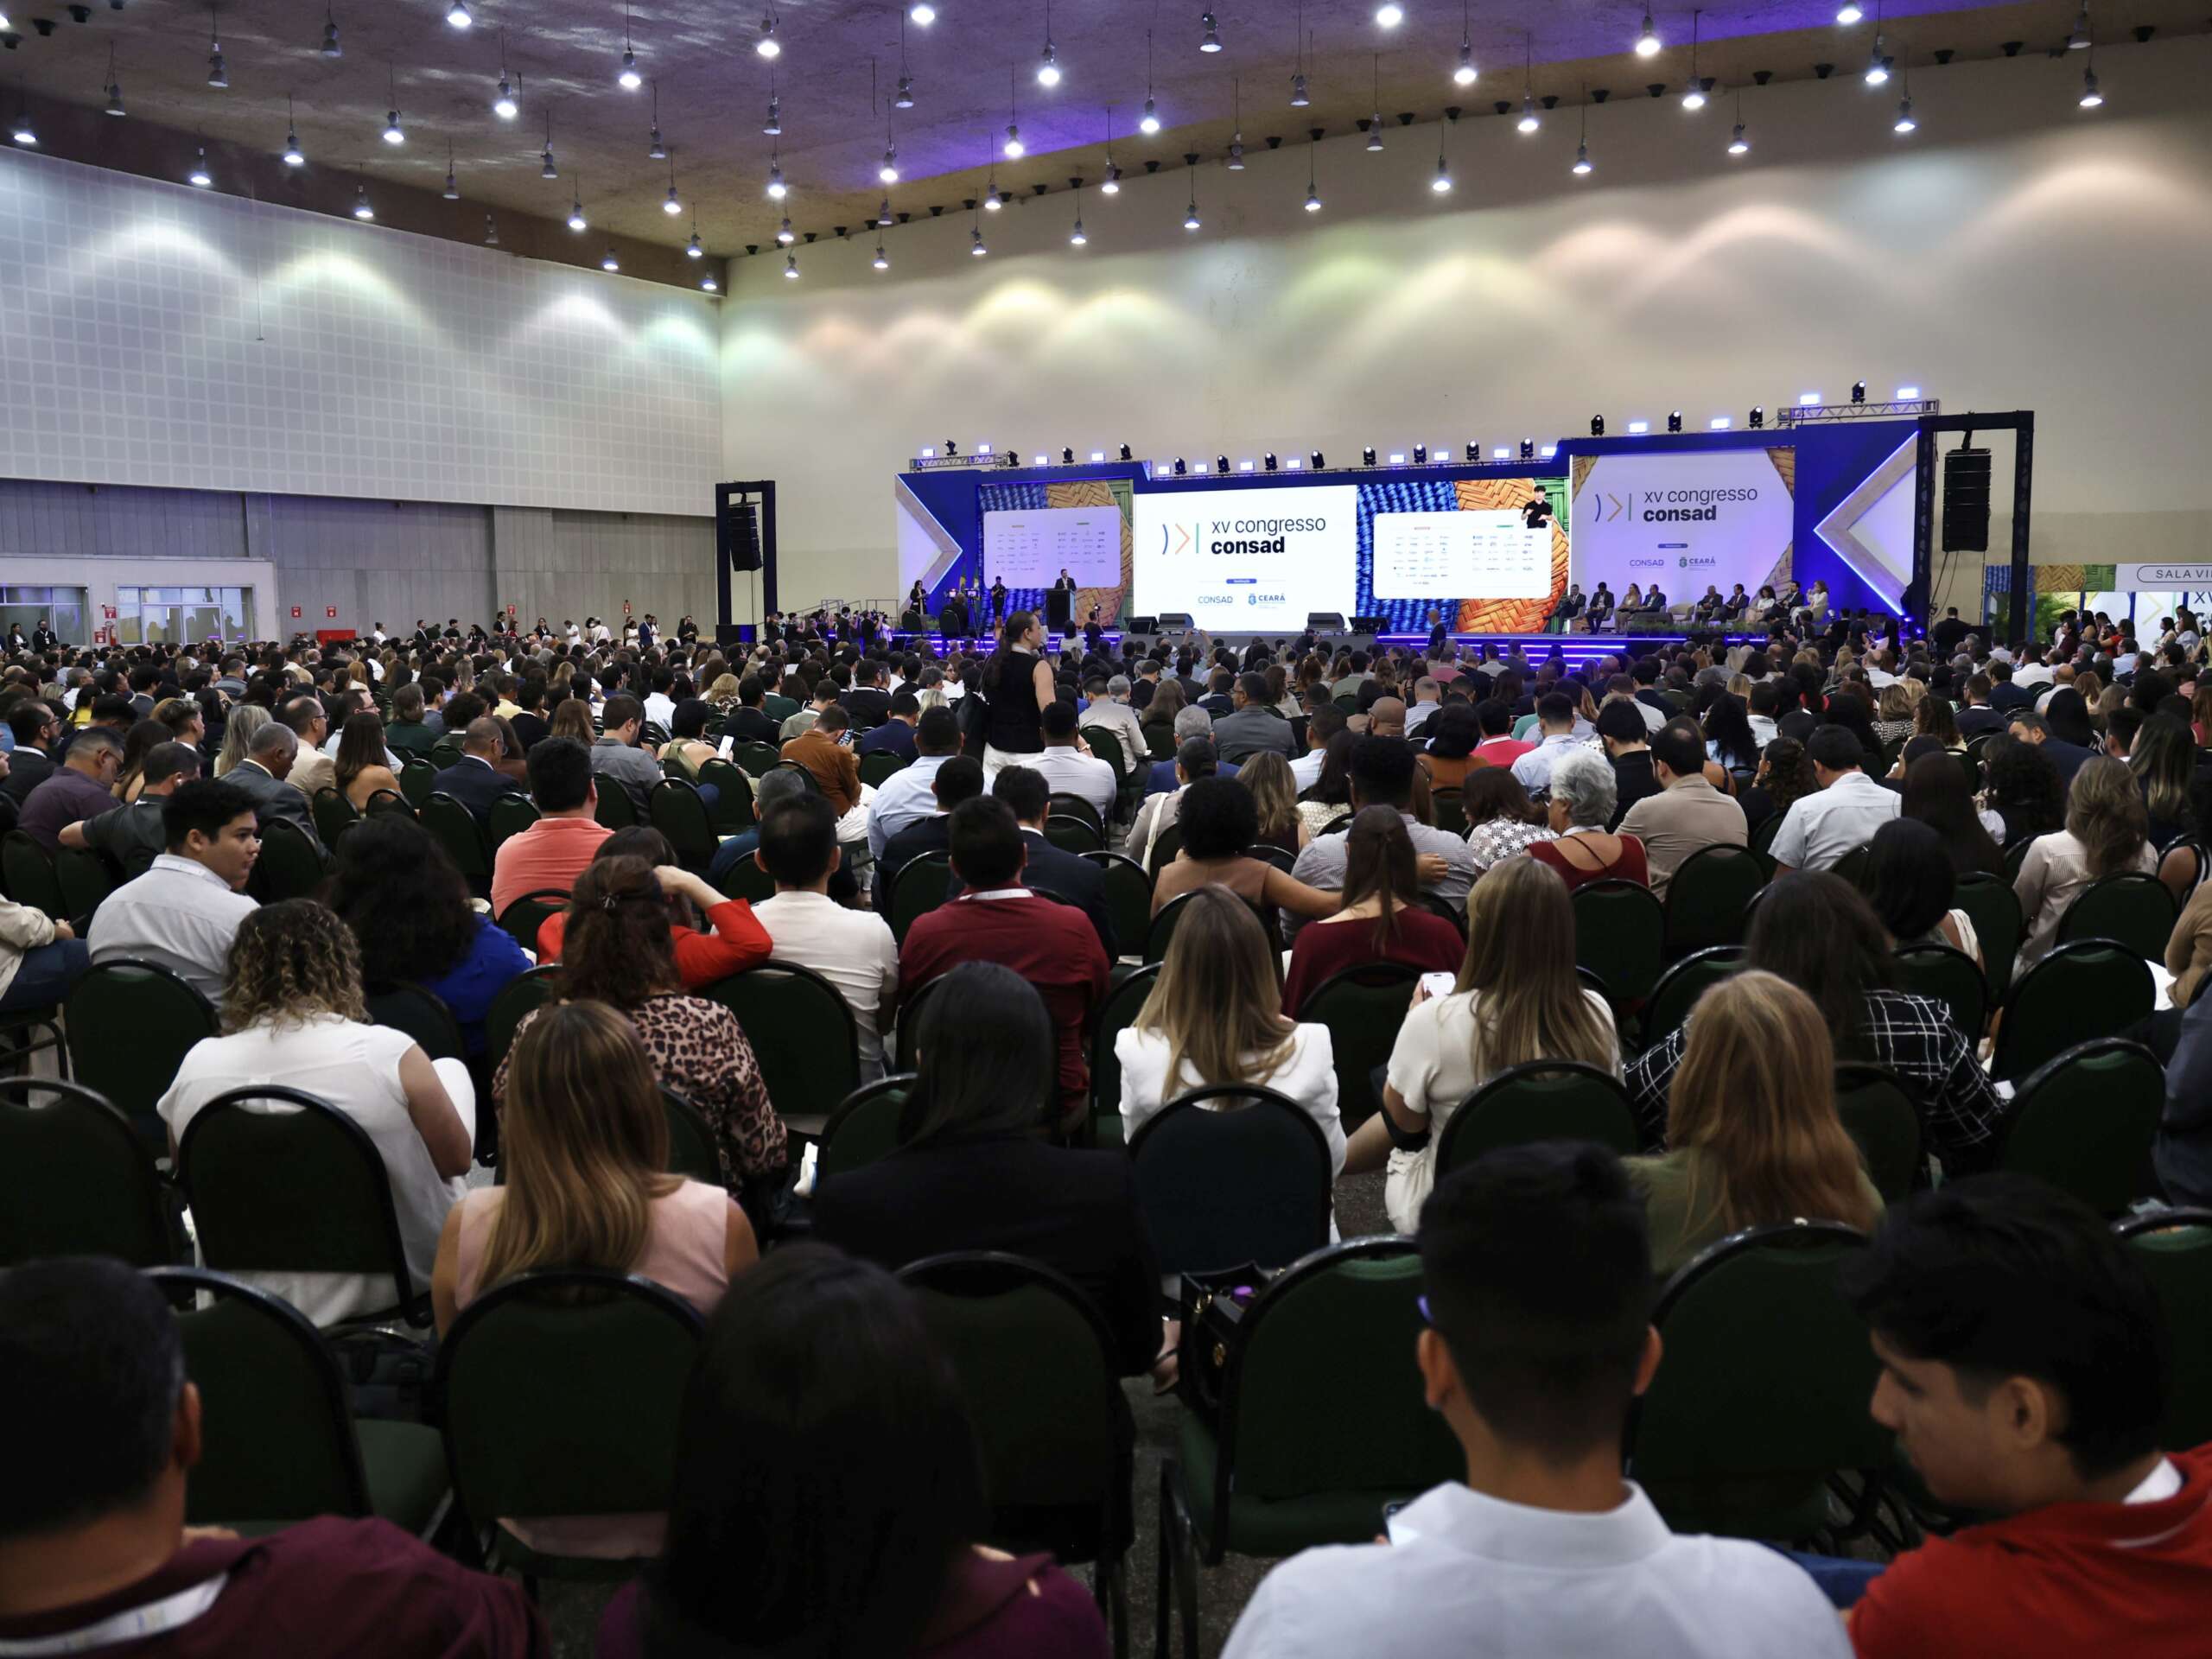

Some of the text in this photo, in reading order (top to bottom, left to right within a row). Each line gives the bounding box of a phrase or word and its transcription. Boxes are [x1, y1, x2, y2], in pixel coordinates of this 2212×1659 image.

[1668, 488, 1758, 505] congresso
[1643, 505, 1717, 522] consad
[1235, 518, 1326, 537] congresso
[1211, 536, 1285, 555] consad
[1688, 556, 1716, 564] CEARÁ
[2156, 569, 2191, 579] SALA
[1198, 595, 1234, 604] CONSAD
[1258, 593, 1286, 601] CEARÁ
